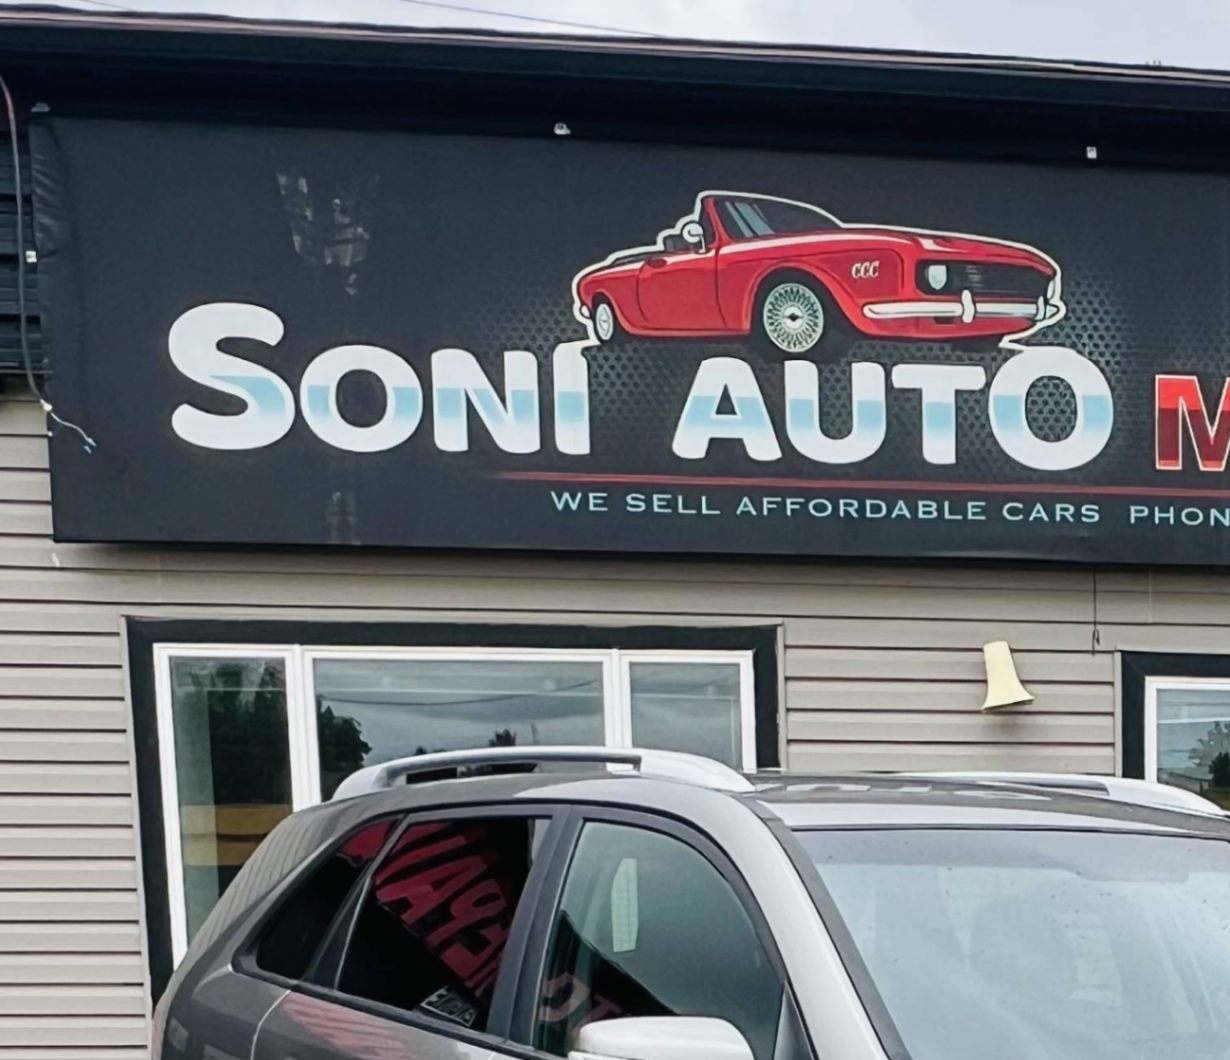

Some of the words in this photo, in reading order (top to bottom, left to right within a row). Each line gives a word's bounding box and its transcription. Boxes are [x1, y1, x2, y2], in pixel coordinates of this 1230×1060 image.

[168, 302, 592, 455] SONI
[671, 345, 1114, 471] AUTO
[550, 490, 609, 512] WE
[625, 492, 722, 515] SELL
[735, 497, 987, 521] AFFORDABLE
[1001, 501, 1101, 523] CARS
